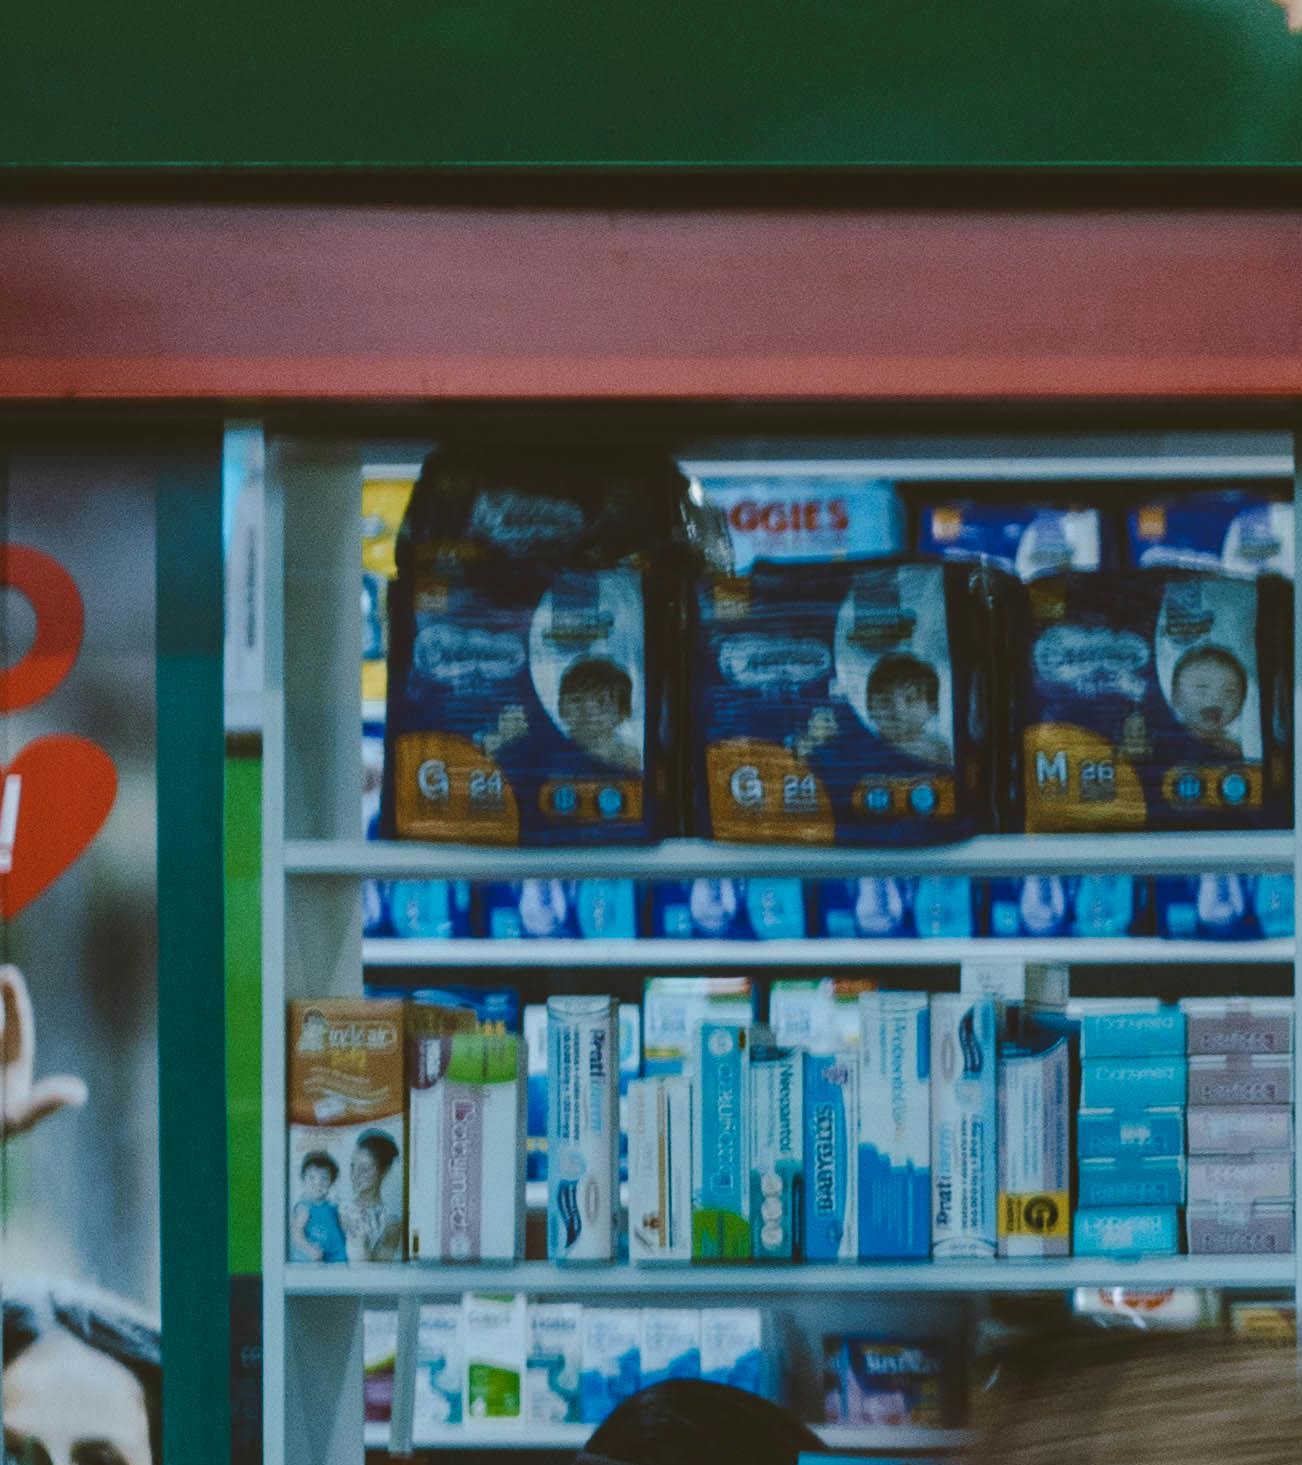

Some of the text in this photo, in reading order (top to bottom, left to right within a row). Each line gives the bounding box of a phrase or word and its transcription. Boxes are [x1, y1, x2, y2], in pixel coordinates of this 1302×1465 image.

[730, 500, 849, 532] GGIES
[417, 758, 450, 800] G
[730, 765, 763, 807] G
[1035, 750, 1068, 788] M
